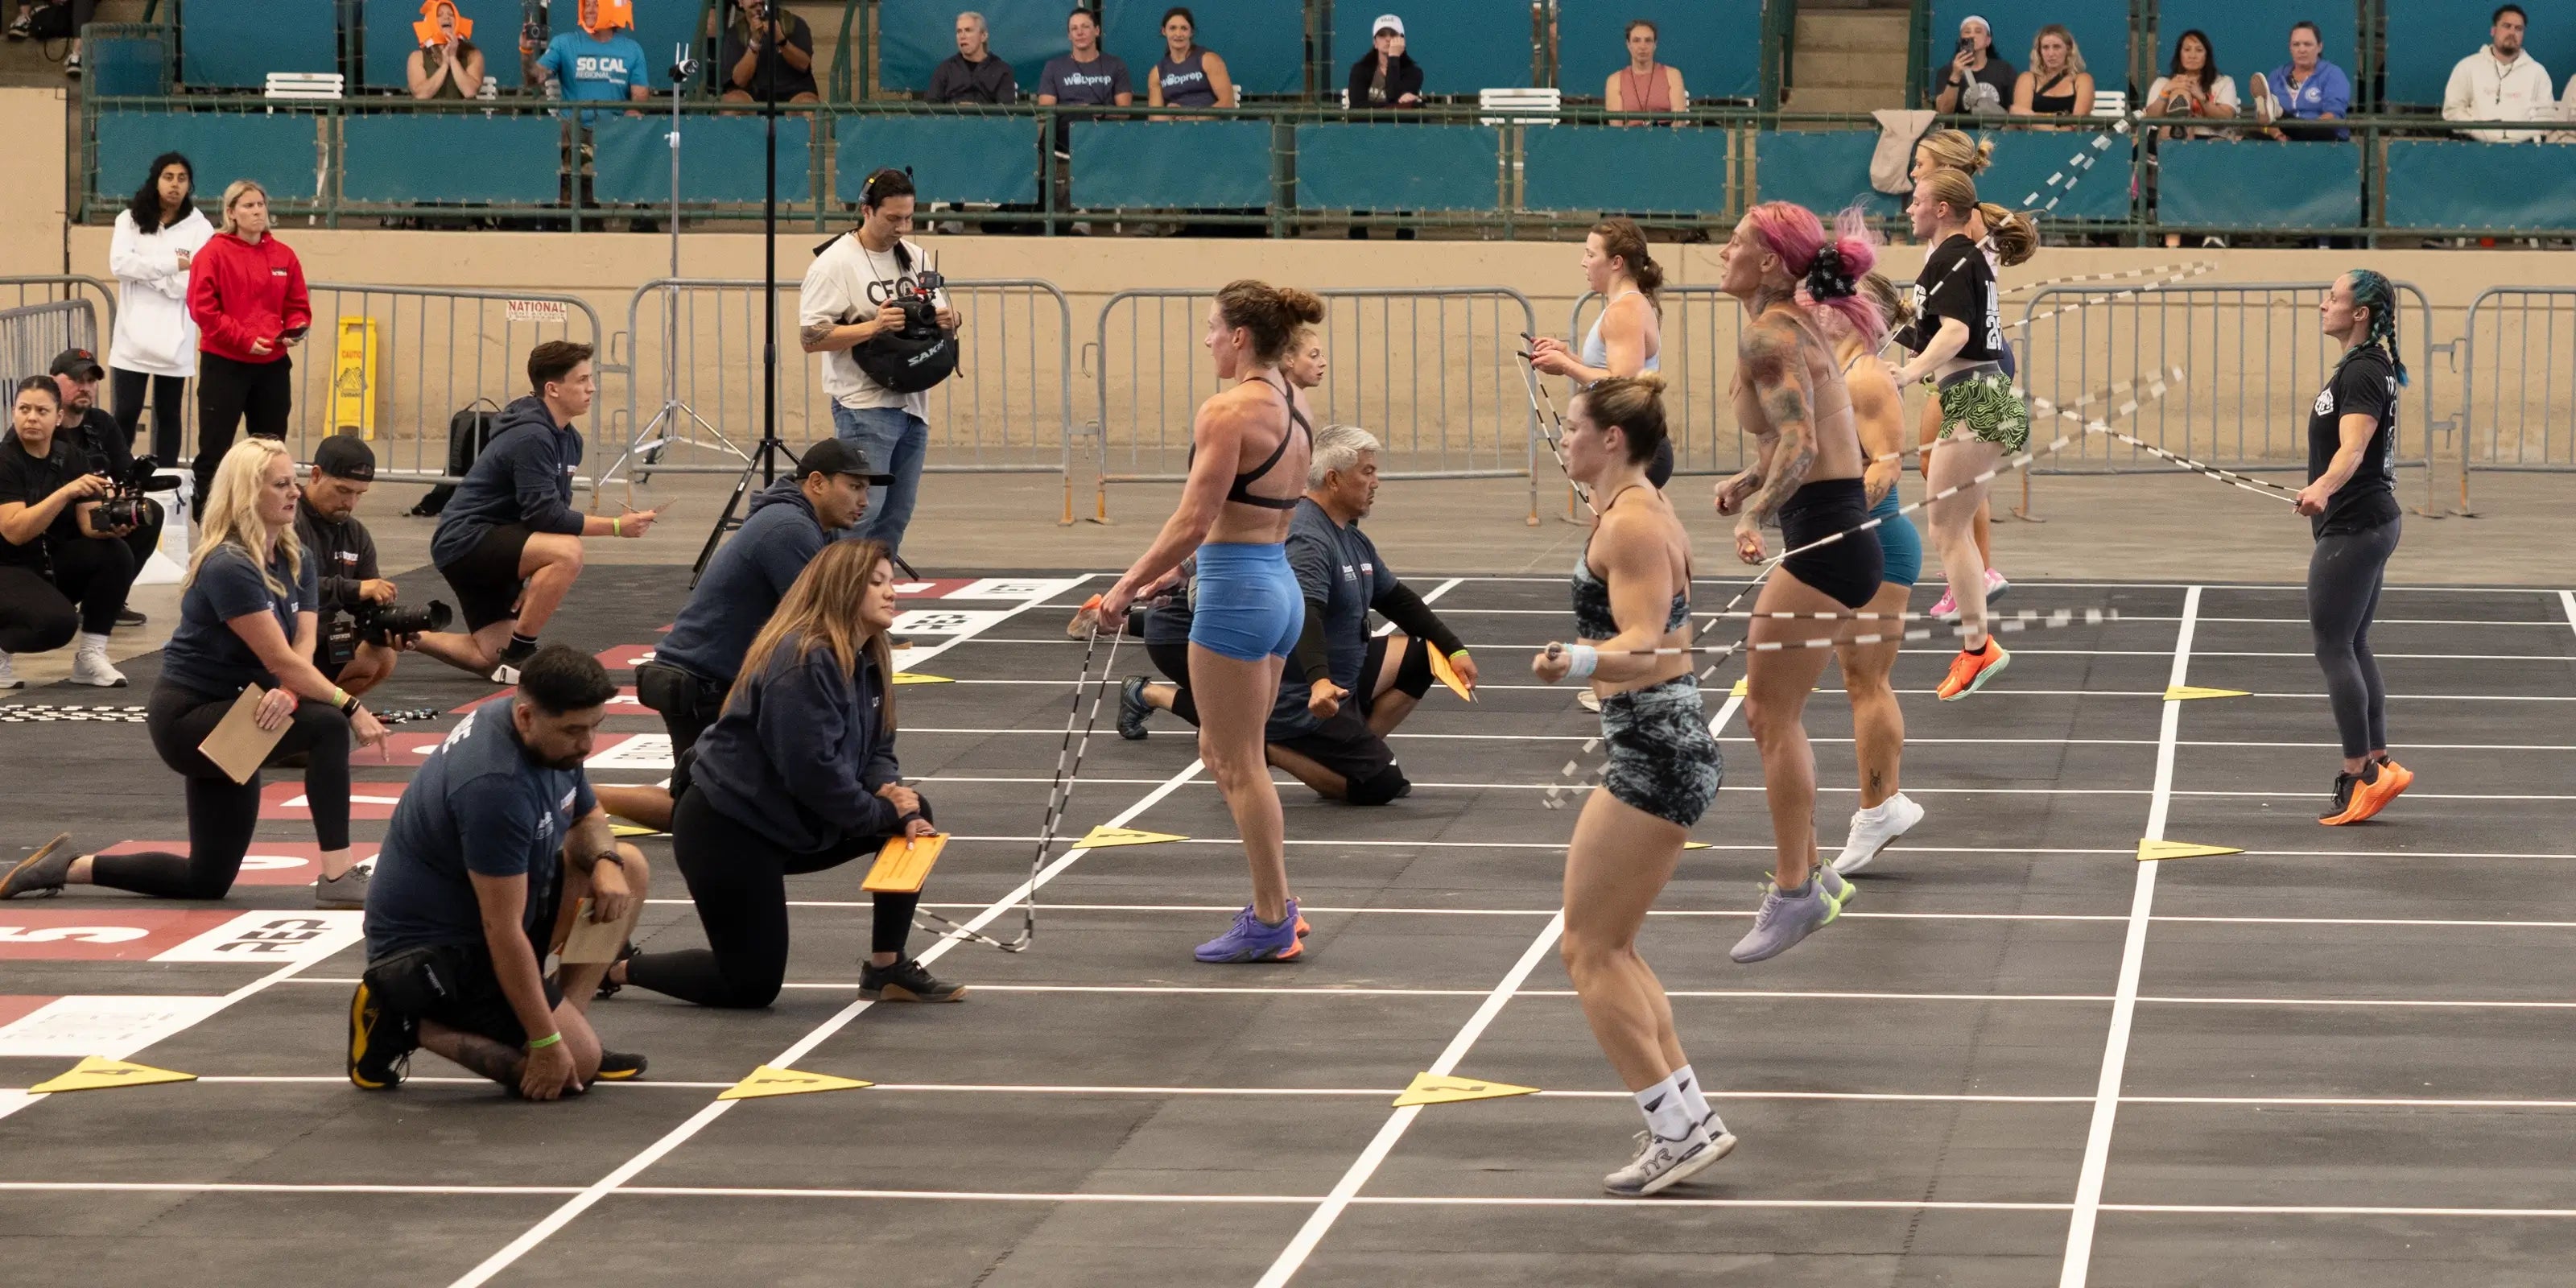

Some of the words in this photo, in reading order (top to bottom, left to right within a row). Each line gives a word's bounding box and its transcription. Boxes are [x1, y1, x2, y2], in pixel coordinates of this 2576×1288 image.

[576, 57, 597, 72] SO
[600, 57, 627, 73] CAL
[576, 71, 611, 79] REGIONAL
[508, 301, 566, 312] NATIONAL
[341, 350, 362, 359] CAUTIO
[213, 919, 332, 953] REP
[1640, 1147, 1673, 1177] TYR
